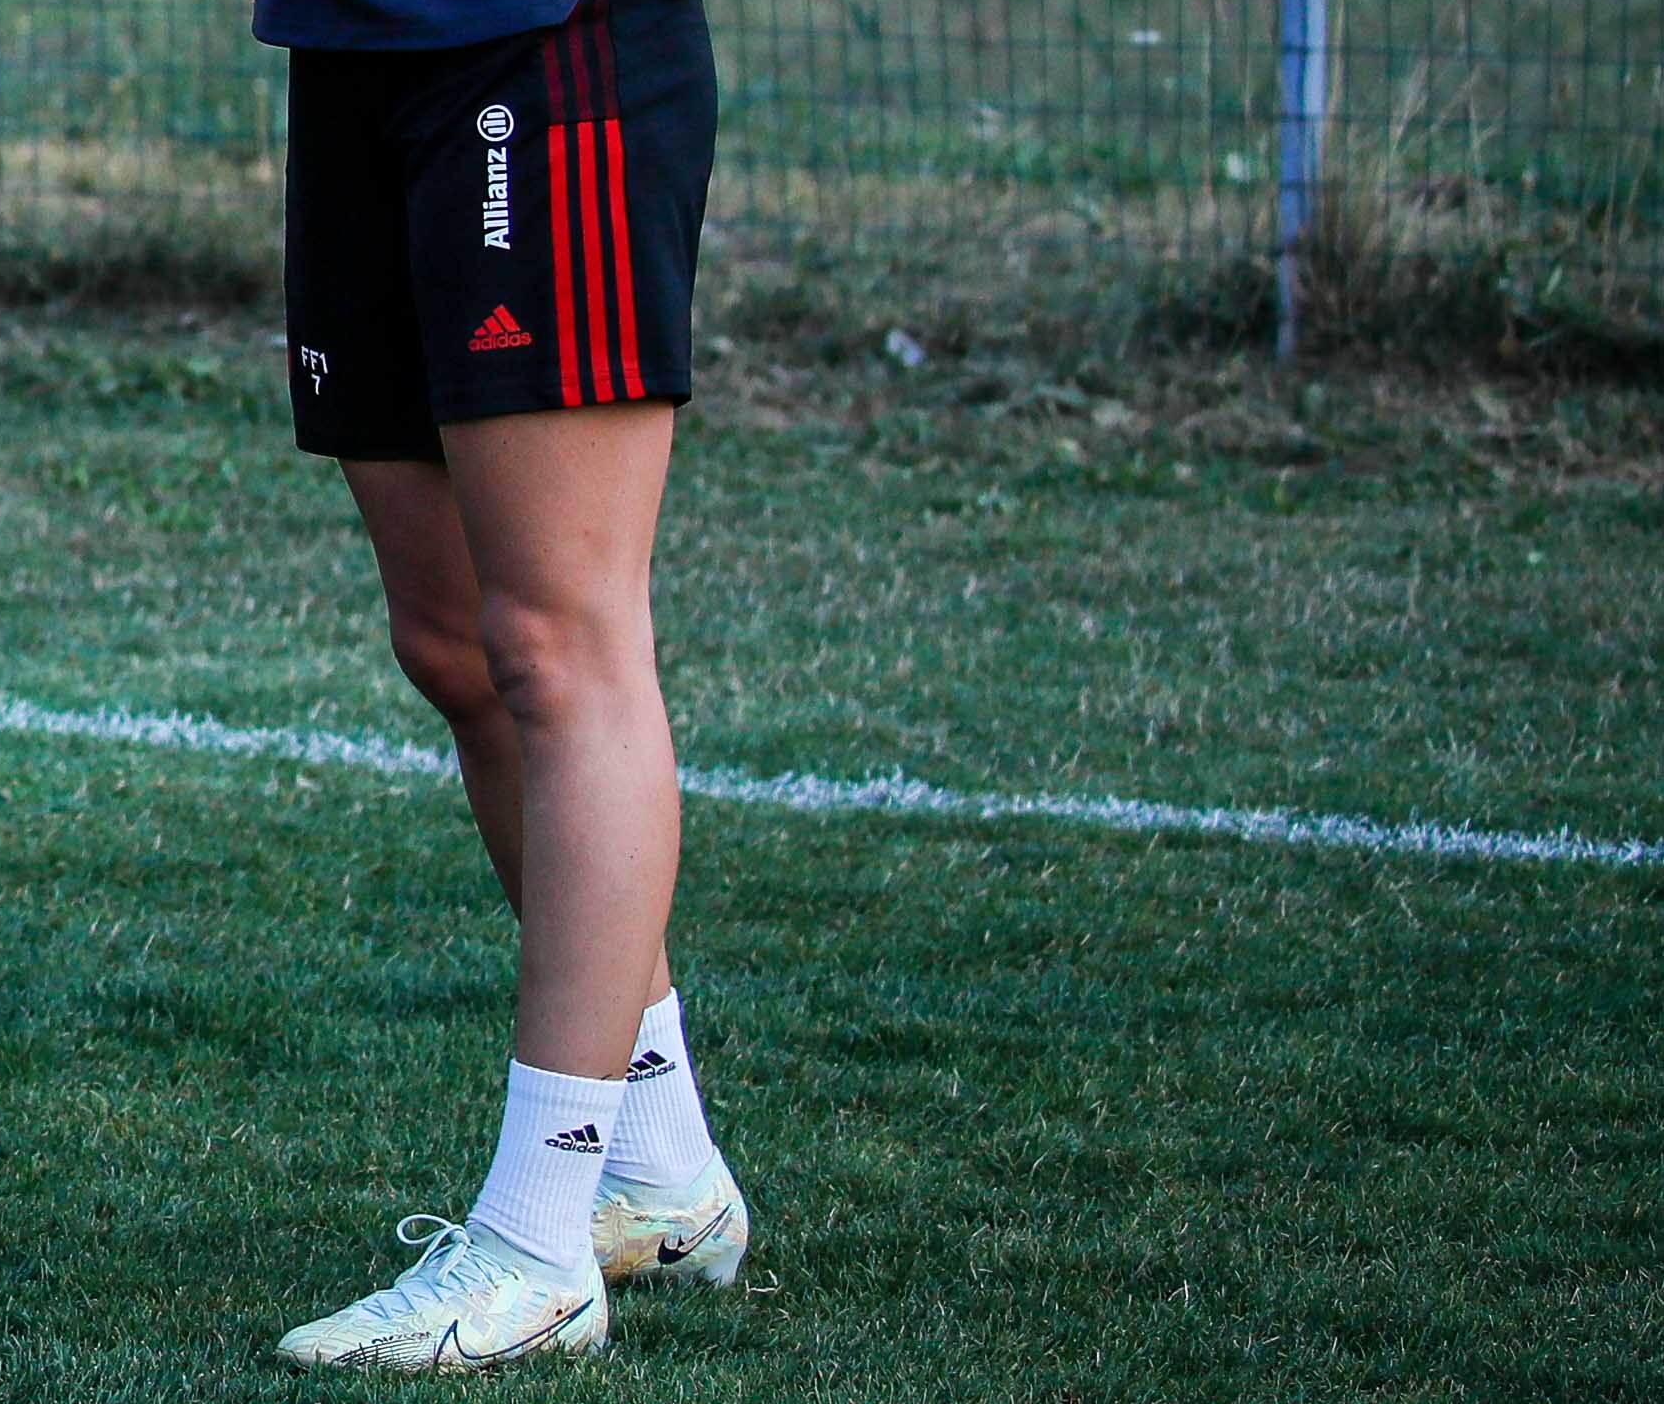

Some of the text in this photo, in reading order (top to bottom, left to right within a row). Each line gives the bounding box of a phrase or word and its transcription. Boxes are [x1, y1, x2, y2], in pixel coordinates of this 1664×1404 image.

[483, 147, 511, 250] Allianz
[468, 332, 532, 352] adidas
[301, 345, 329, 374] FF1
[311, 373, 321, 396] 7
[545, 1137, 604, 1155] adidas
